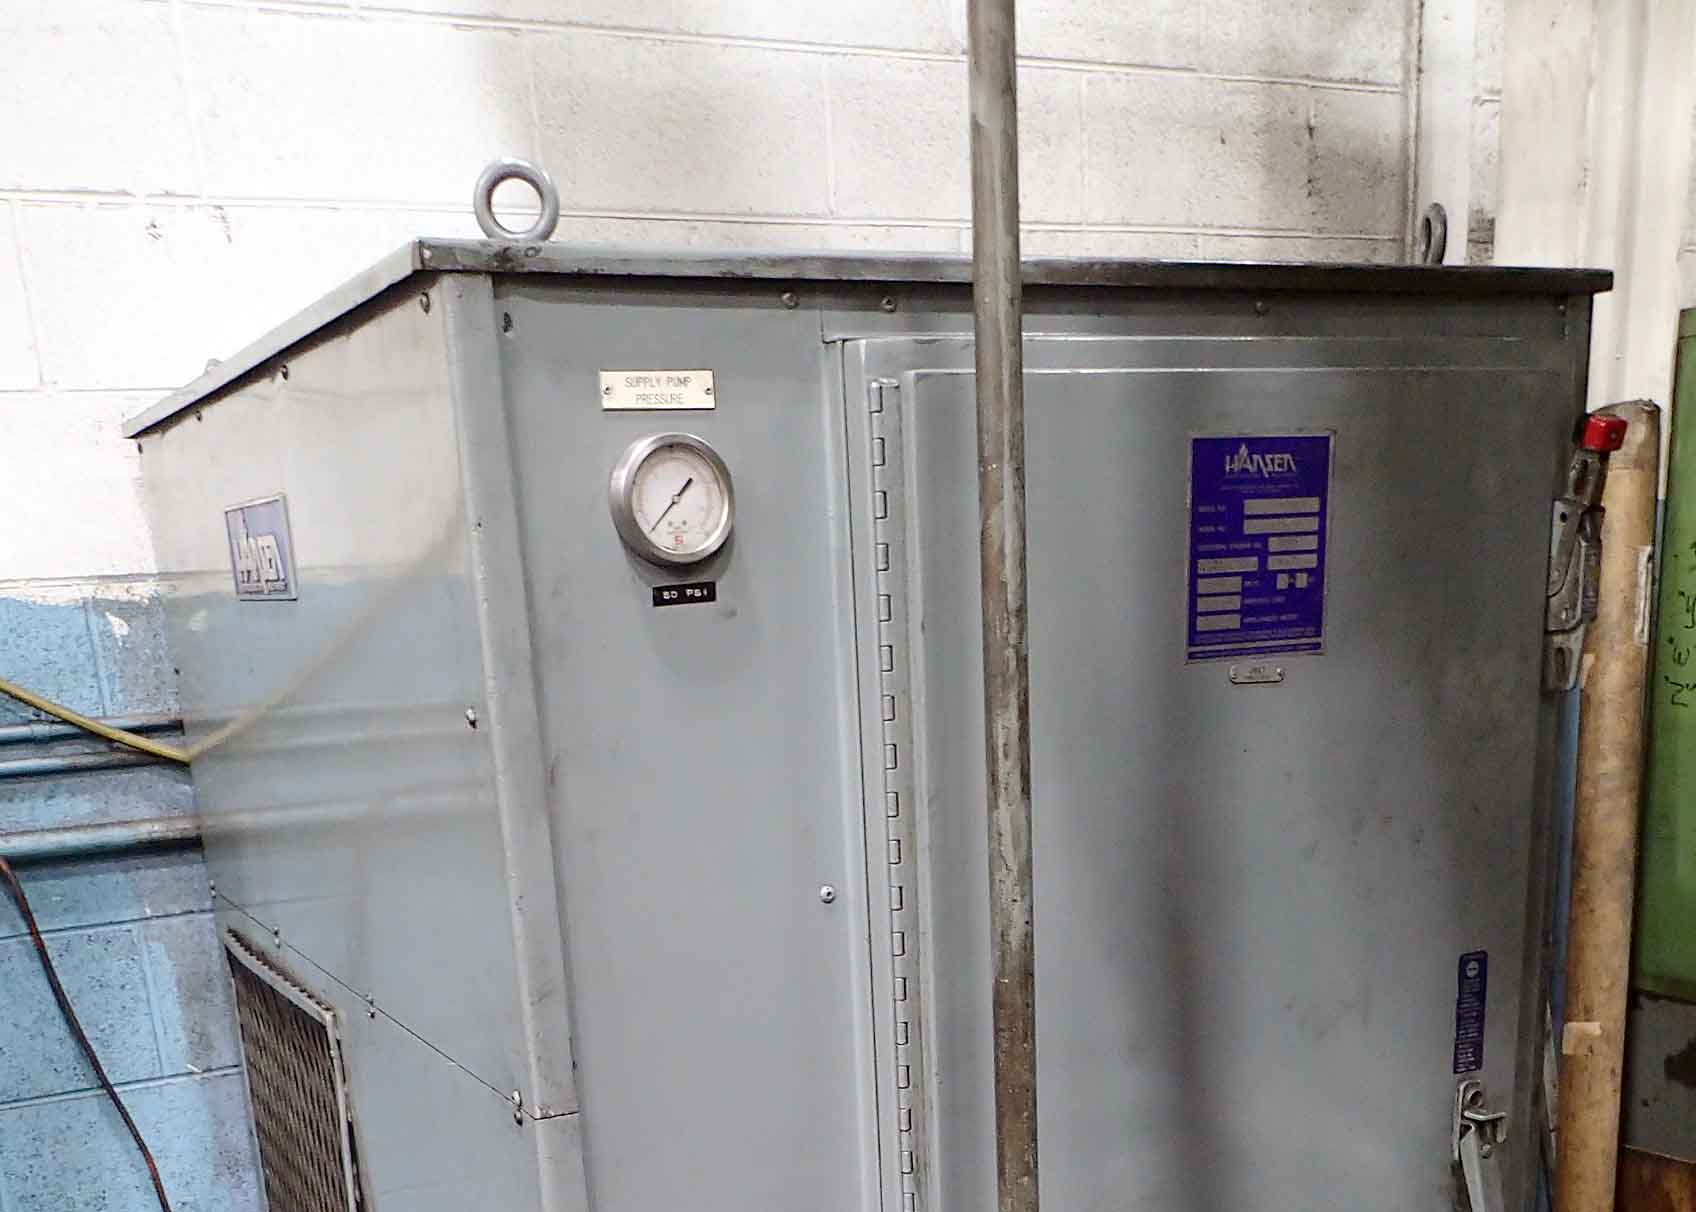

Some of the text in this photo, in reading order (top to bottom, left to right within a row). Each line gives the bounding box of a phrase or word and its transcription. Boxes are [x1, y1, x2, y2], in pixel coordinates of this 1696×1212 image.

[624, 376, 693, 388] SUPPLY PUMP
[635, 393, 685, 405] PRESSURE
[1225, 443, 1297, 478] HANSEN
